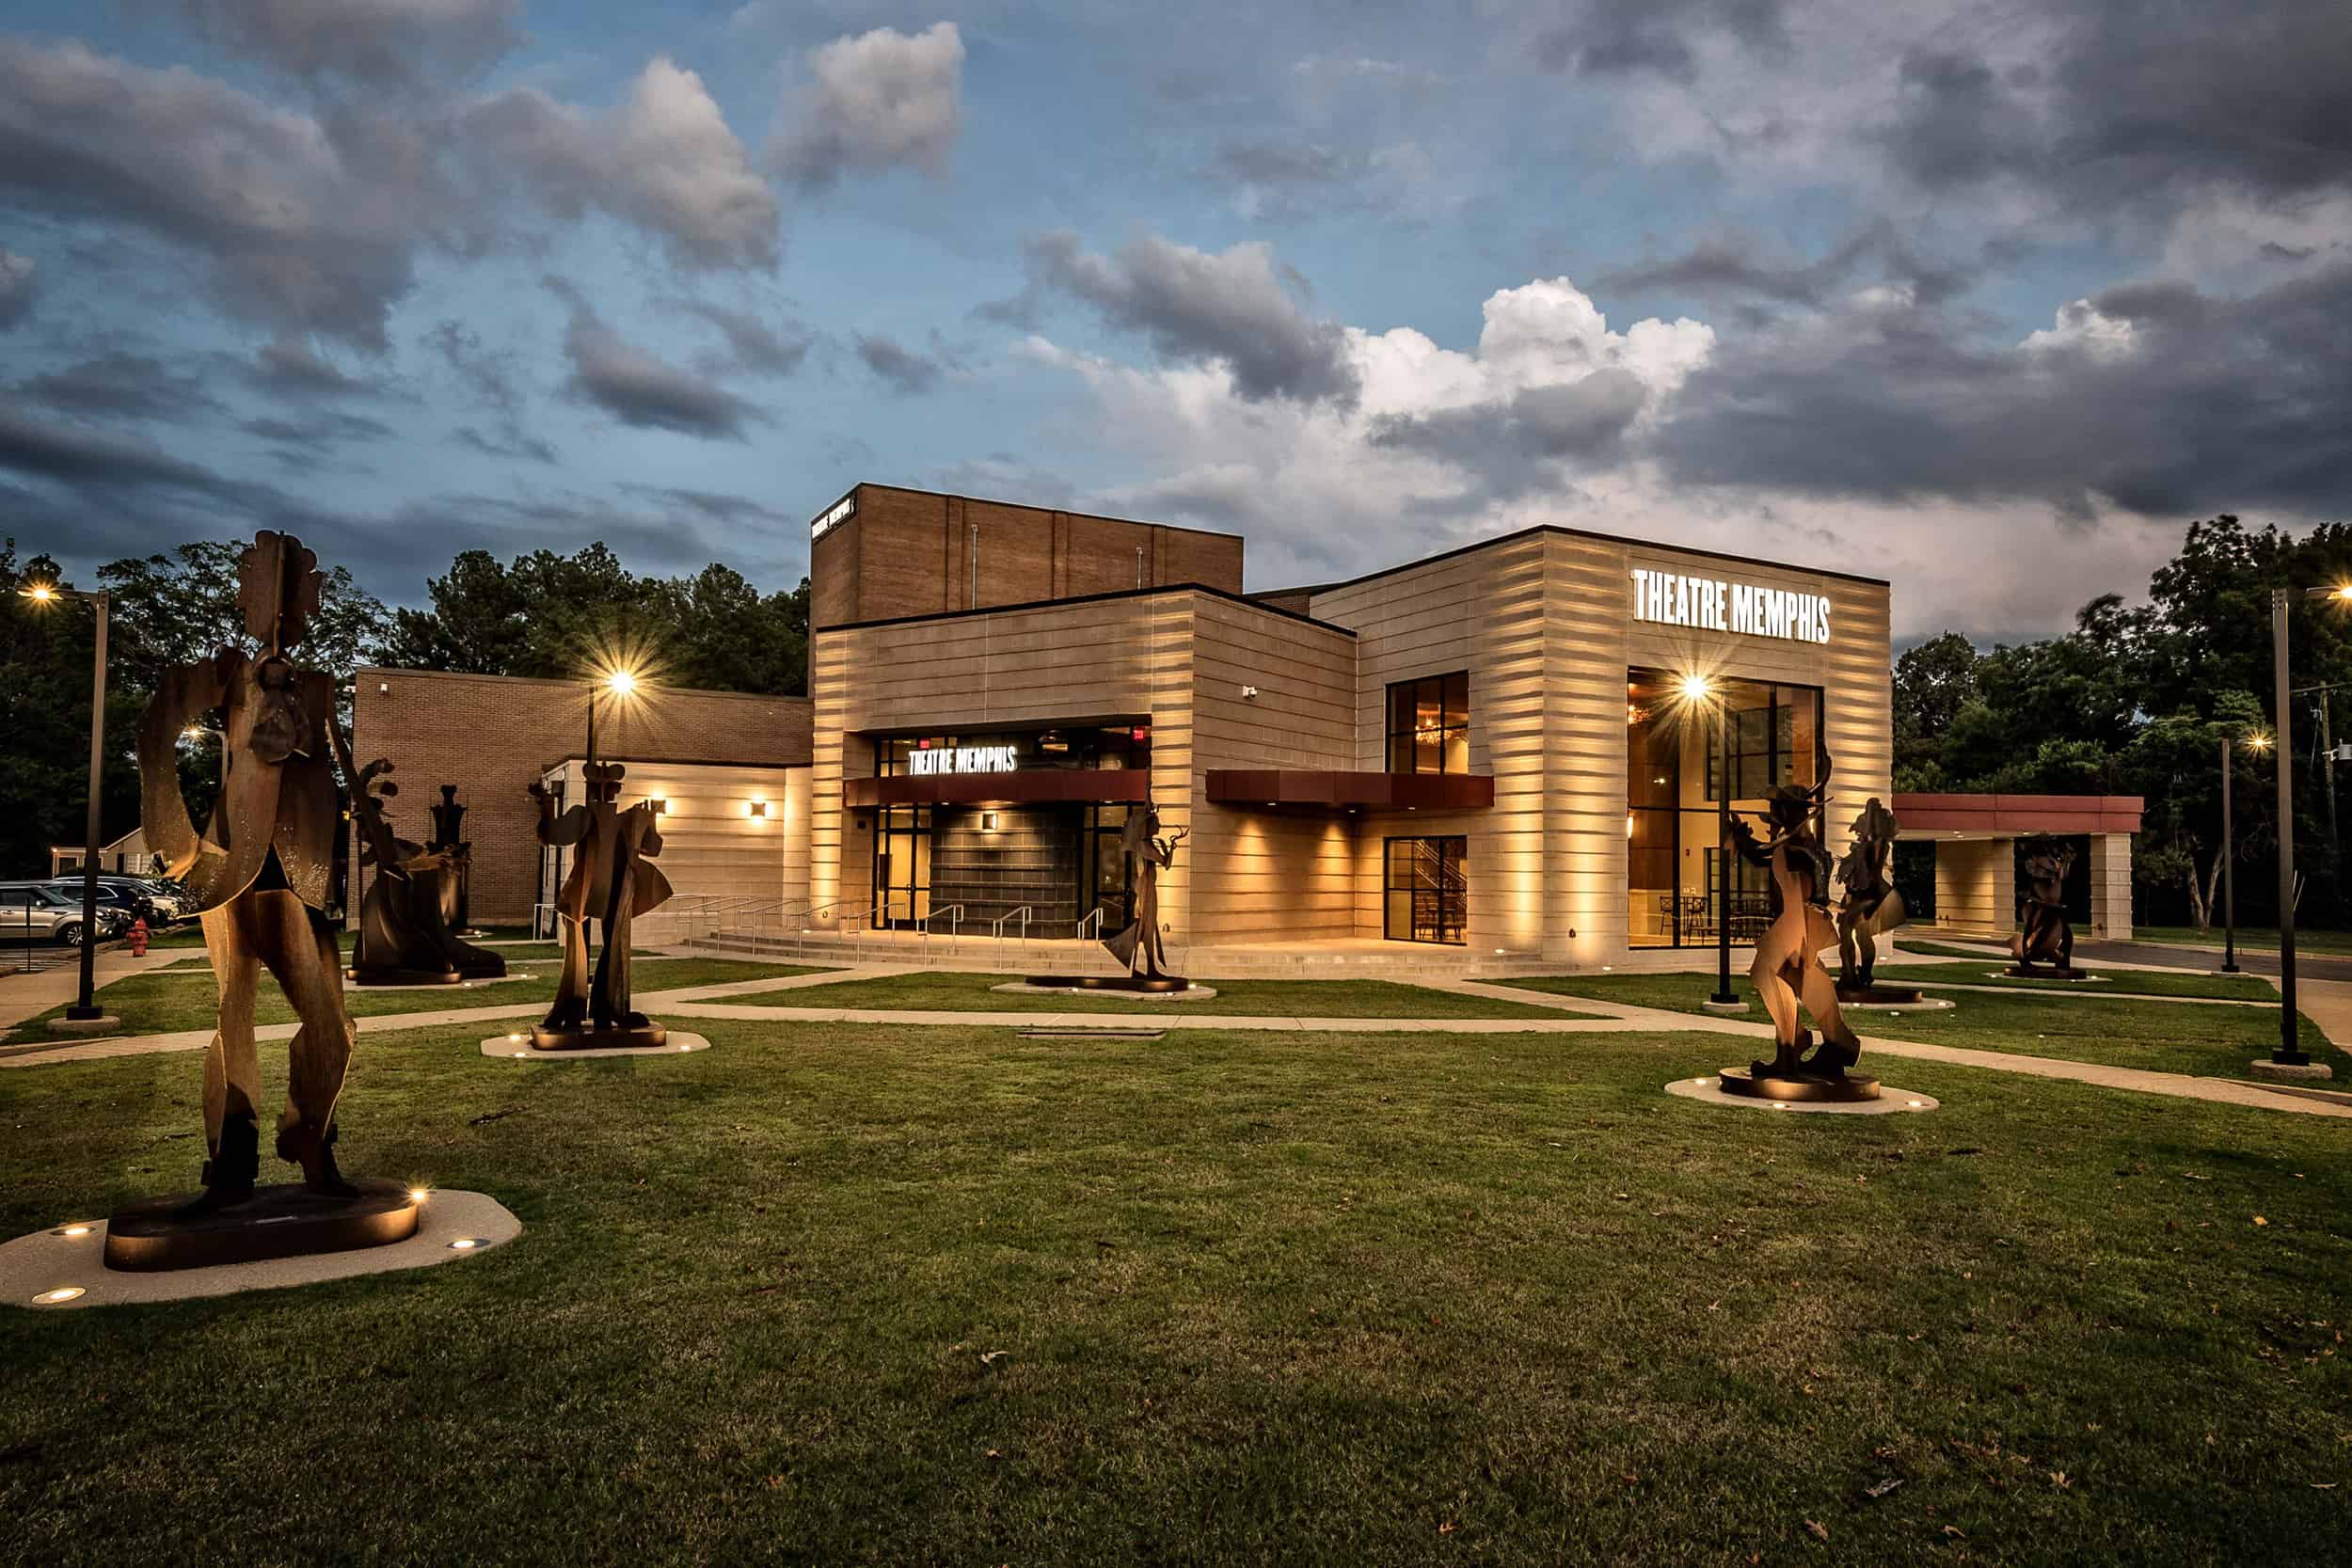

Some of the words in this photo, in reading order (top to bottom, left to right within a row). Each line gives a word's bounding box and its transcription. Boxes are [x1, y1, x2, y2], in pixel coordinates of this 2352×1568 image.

[1629, 568, 1727, 631] THEATRE
[1731, 583, 1831, 644] MEMPHIS
[909, 748, 954, 776] THEATRE
[955, 745, 1017, 774] MEMPHIS
